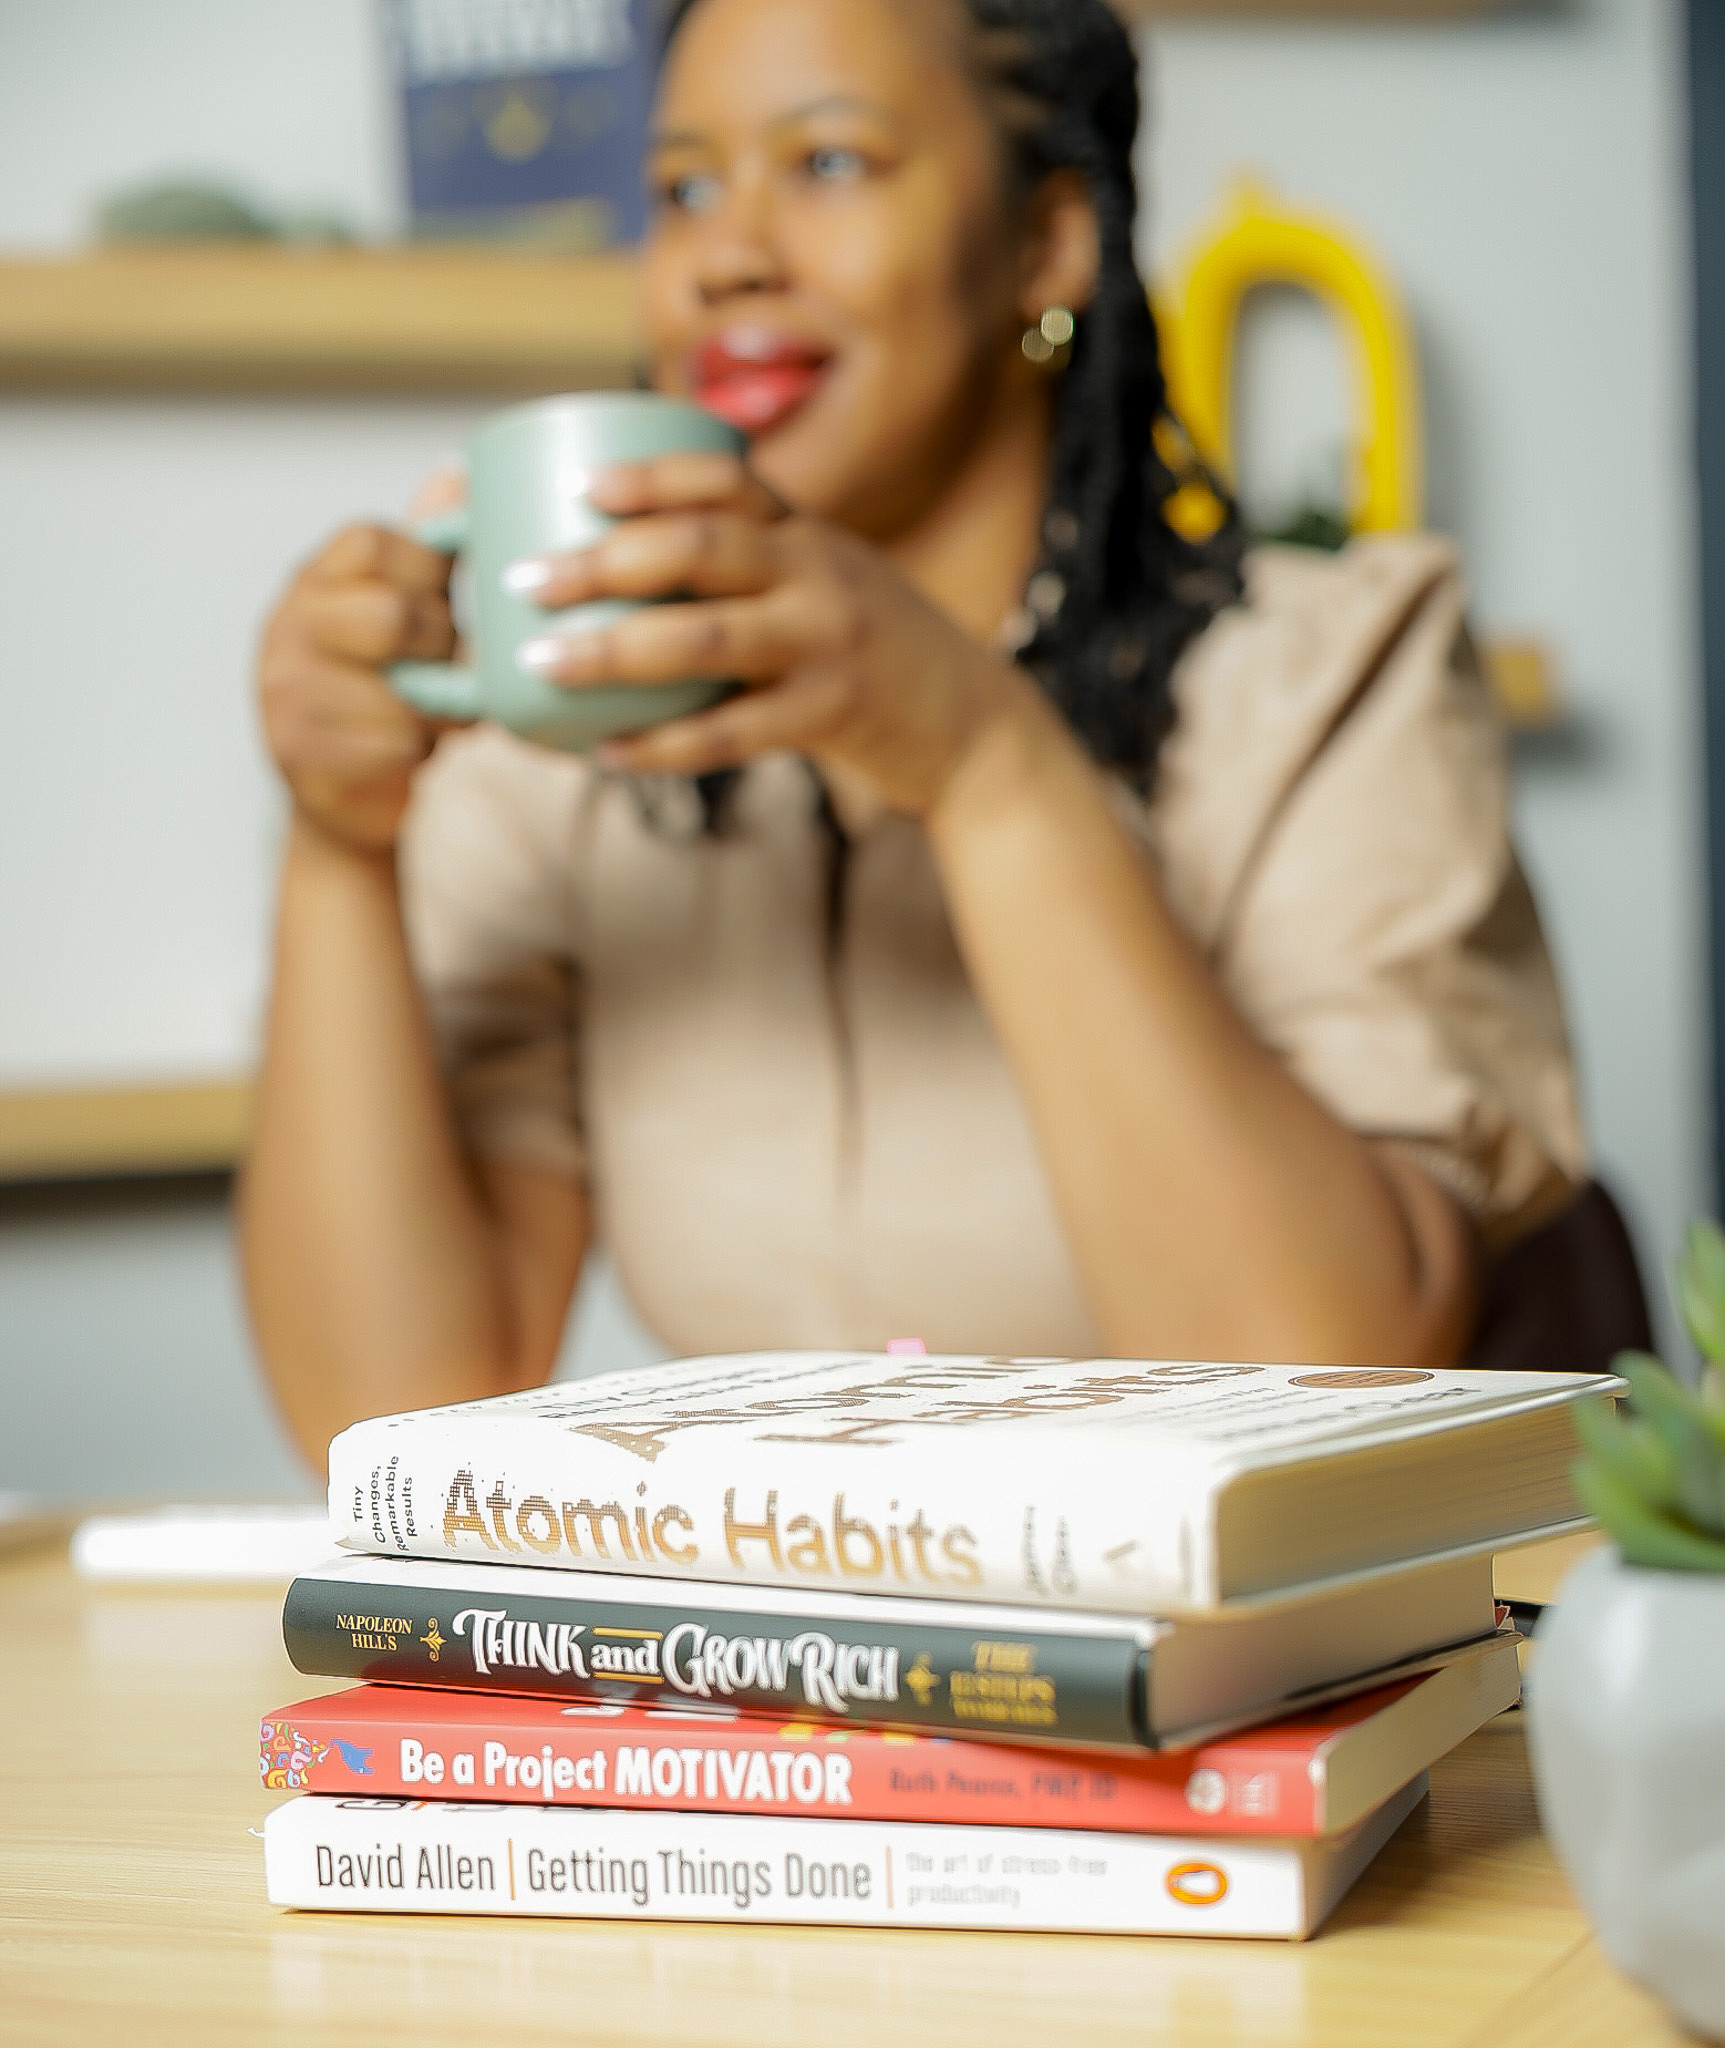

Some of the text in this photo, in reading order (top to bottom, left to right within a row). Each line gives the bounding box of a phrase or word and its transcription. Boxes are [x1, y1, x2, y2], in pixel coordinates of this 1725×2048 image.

[752, 1365, 1265, 1446] Habits
[352, 1486, 363, 1523] Tiny
[371, 1465, 386, 1544] Changes,
[385, 1456, 410, 1552] Remarkable
[402, 1477, 418, 1537] Results
[443, 1469, 699, 1564] Atomic
[723, 1486, 984, 1587] Habits
[335, 1613, 413, 1635] NAPOLEON
[351, 1632, 398, 1651] HILL'S
[452, 1609, 592, 1679] THINK
[590, 1637, 660, 1675] and
[662, 1622, 791, 1699] GROW
[789, 1631, 900, 1714] RICH
[400, 1737, 852, 1806] Be a Project MOTIVATOR
[315, 1843, 496, 1891] David Allen
[527, 1847, 872, 1910] Getting Things Done
